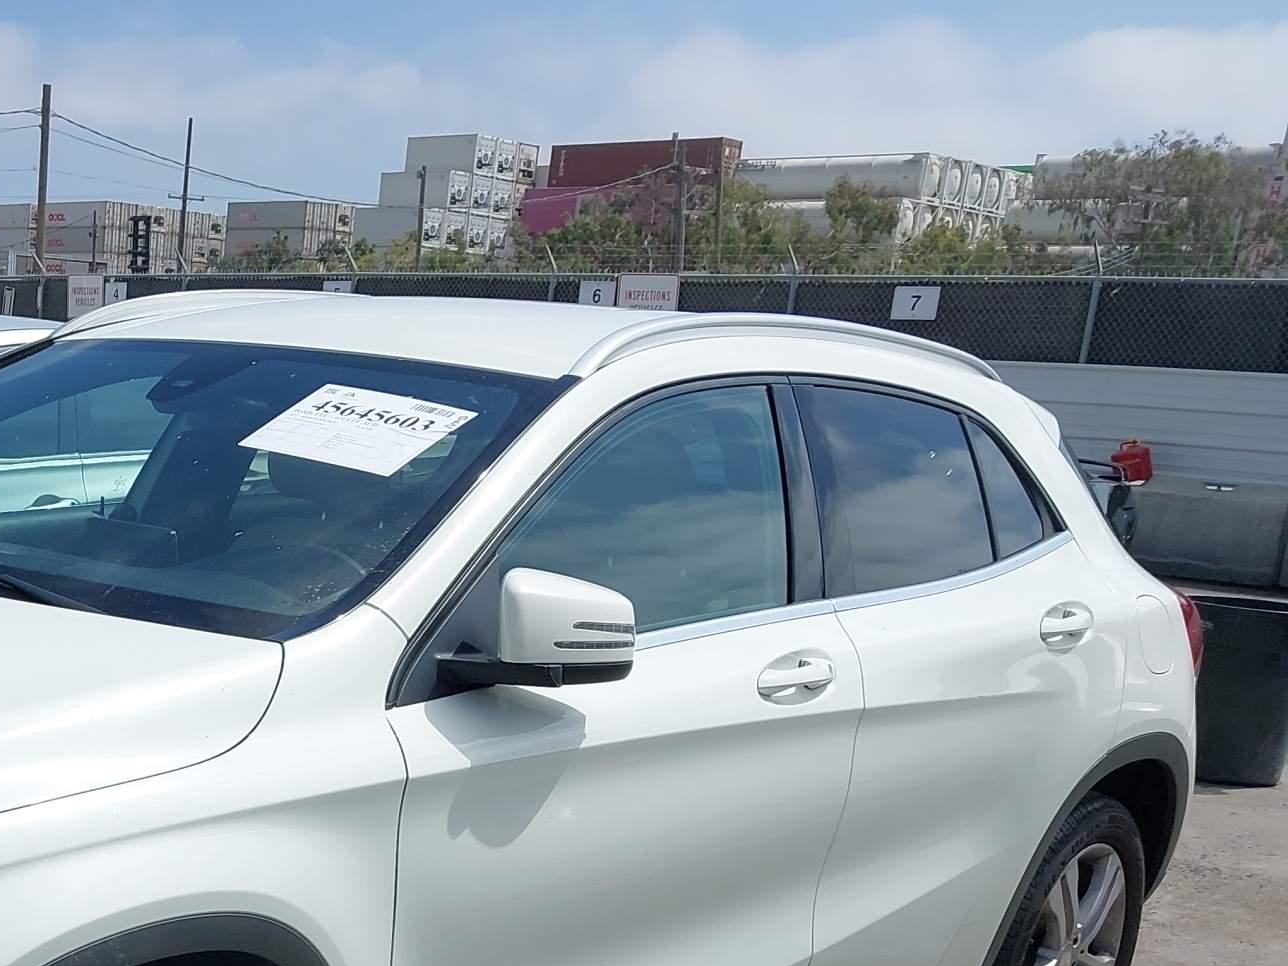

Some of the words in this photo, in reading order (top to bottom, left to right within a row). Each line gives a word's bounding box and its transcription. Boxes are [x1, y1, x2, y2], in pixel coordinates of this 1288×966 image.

[113, 288, 119, 300] 4
[592, 288, 601, 304] 6
[624, 290, 671, 302] INSPECTIONS
[911, 295, 922, 311] 7
[312, 400, 436, 432] 45645603
